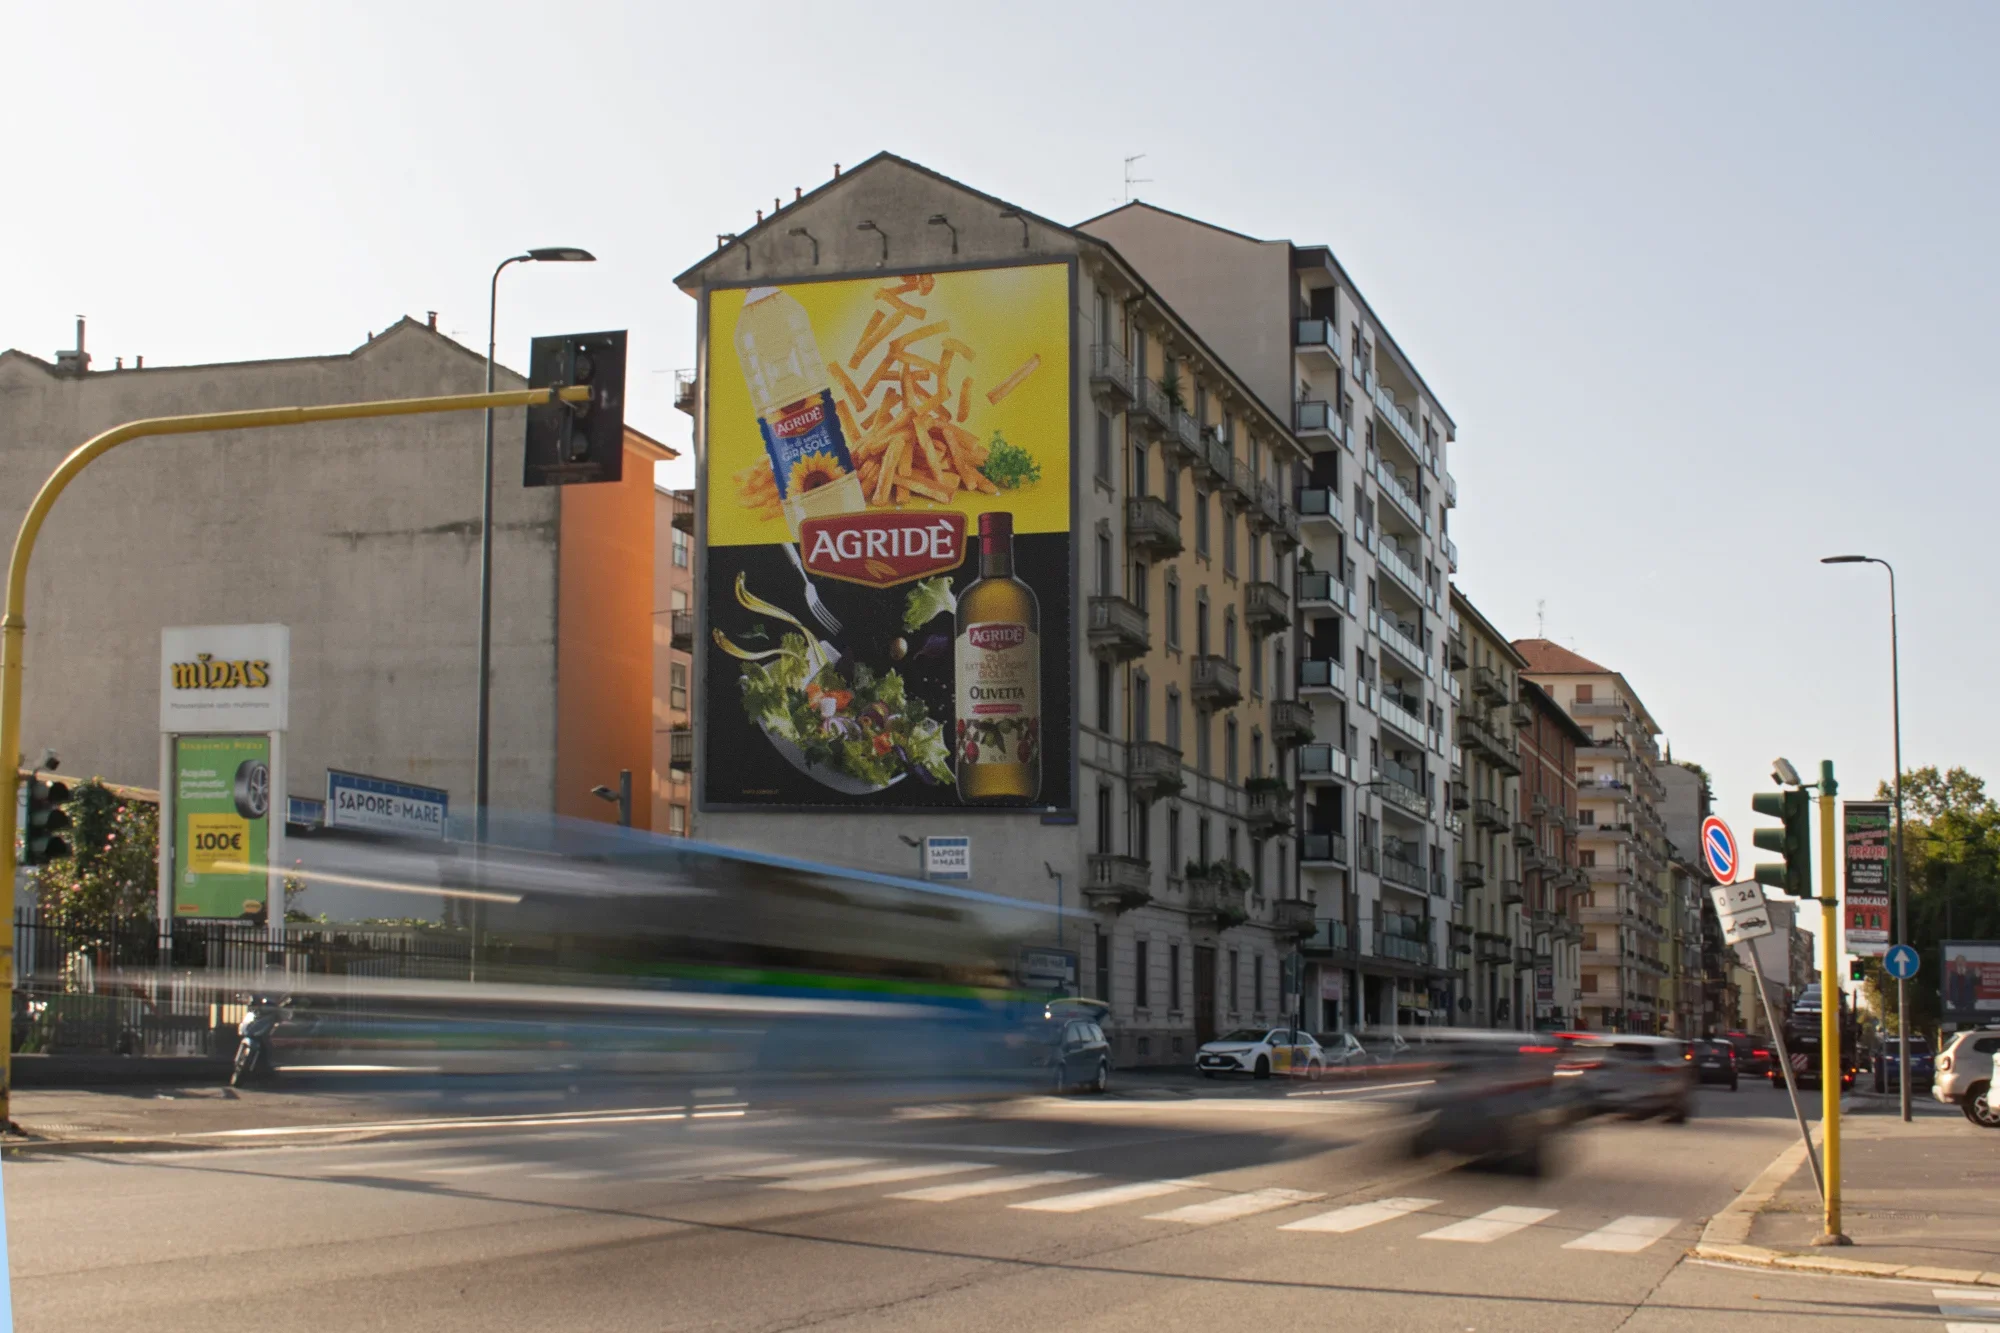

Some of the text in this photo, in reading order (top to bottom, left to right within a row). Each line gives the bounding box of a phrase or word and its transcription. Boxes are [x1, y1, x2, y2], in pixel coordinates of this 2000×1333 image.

[781, 436, 832, 462] GIRASOLE
[808, 518, 955, 563] AGRIDÈ
[971, 626, 1024, 643] AGRIDÈ
[339, 791, 393, 816] SAPORE
[402, 803, 440, 824] MARE
[195, 832, 242, 850] 100€
[931, 848, 965, 857] SAPORE
[1719, 897, 1726, 906] 0
[1738, 888, 1756, 903] 24
